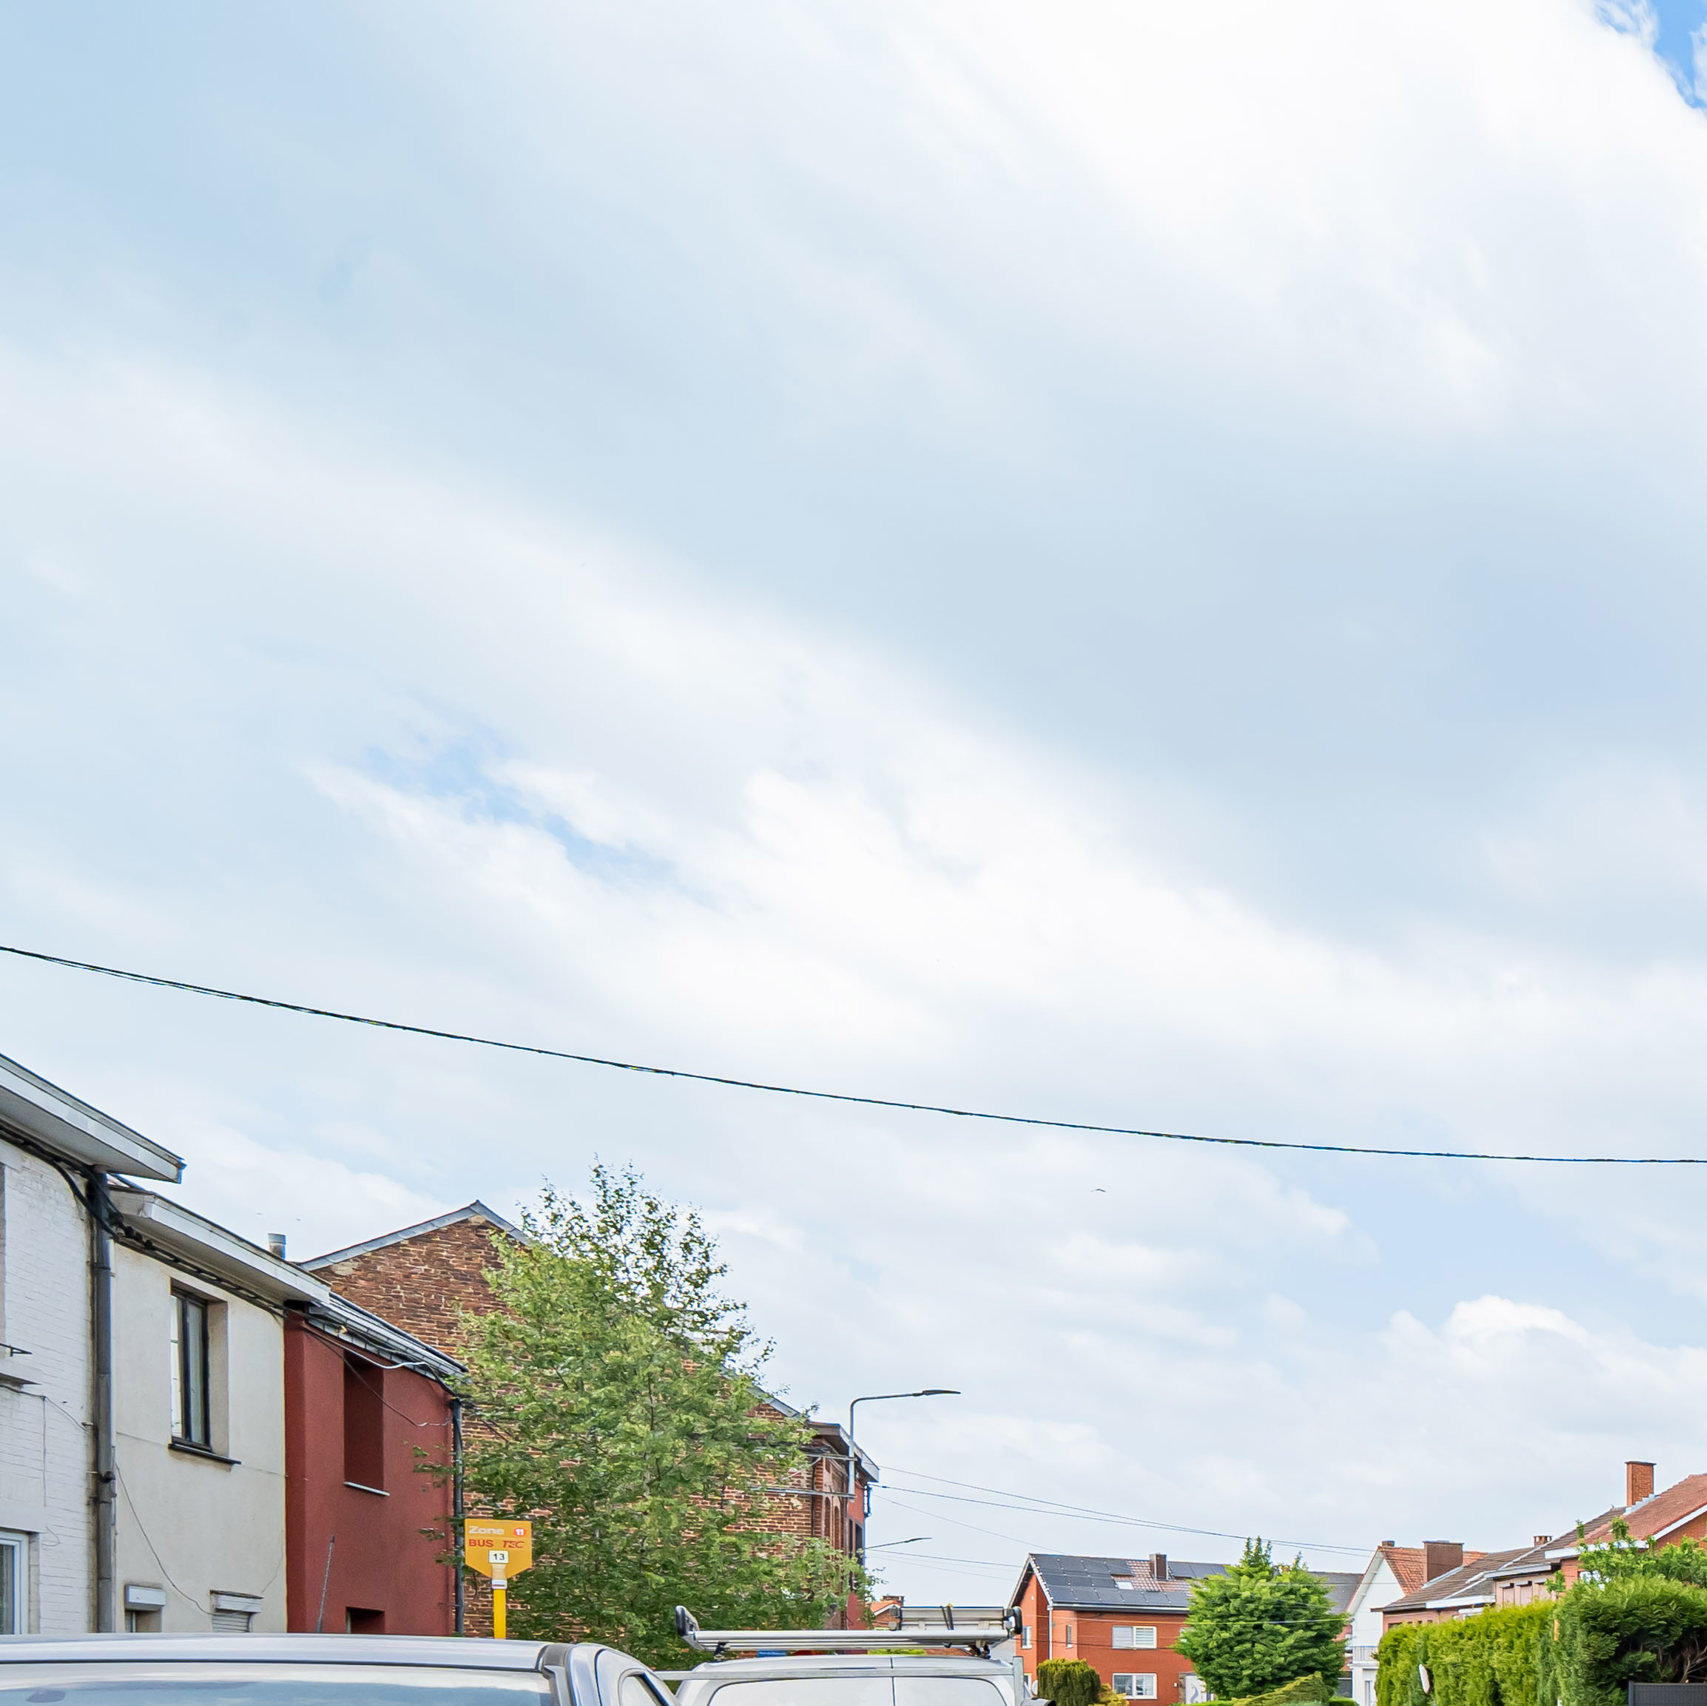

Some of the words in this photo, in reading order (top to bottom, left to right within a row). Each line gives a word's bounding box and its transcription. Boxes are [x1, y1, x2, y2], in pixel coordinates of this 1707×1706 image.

[468, 1525, 504, 1535] Zone
[515, 1528, 524, 1536] 11
[468, 1539, 494, 1547] BUS
[502, 1540, 525, 1548] TEC
[493, 1553, 505, 1561] 13
